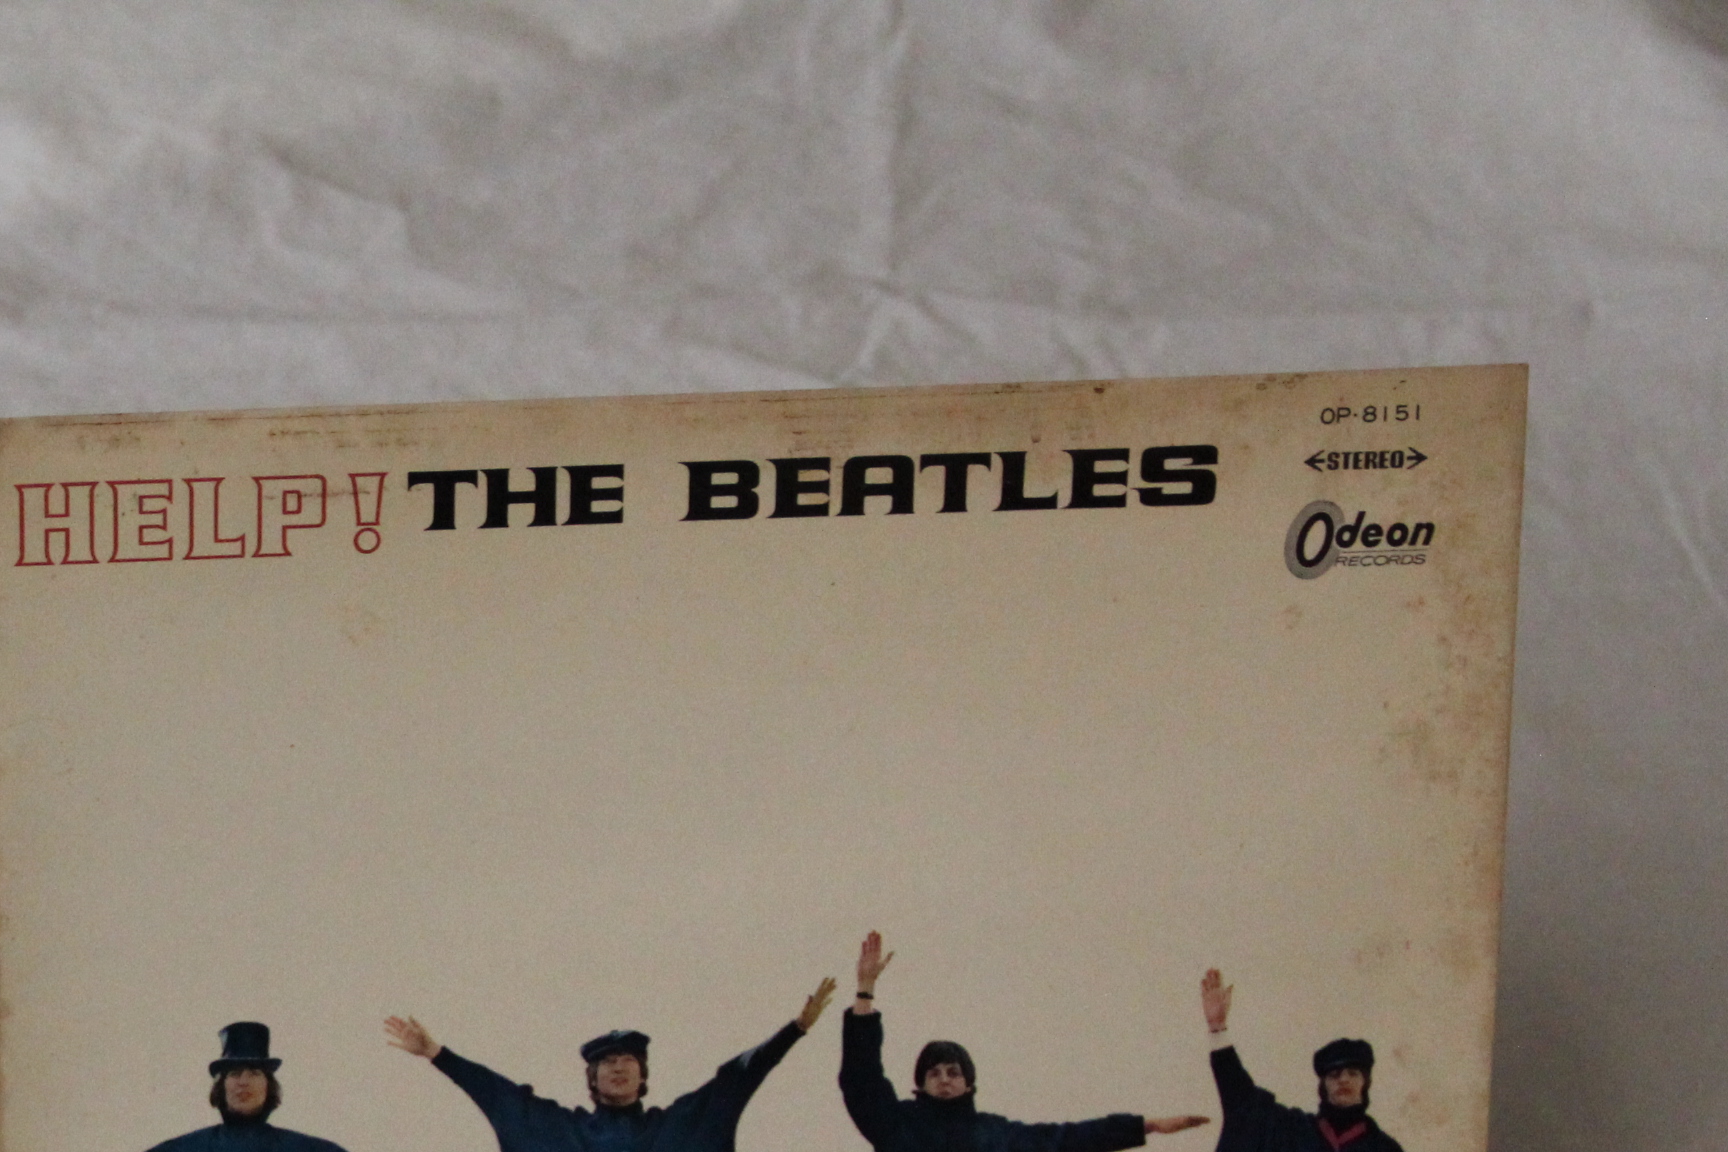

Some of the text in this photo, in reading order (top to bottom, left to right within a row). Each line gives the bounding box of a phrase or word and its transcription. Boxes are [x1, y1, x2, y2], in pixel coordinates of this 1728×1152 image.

[1327, 450, 1404, 470] STEREO
[14, 444, 1219, 567] HELP! THE BEATLES
[1295, 510, 1436, 568] Odeon
[1335, 553, 1426, 567] RECORDS
